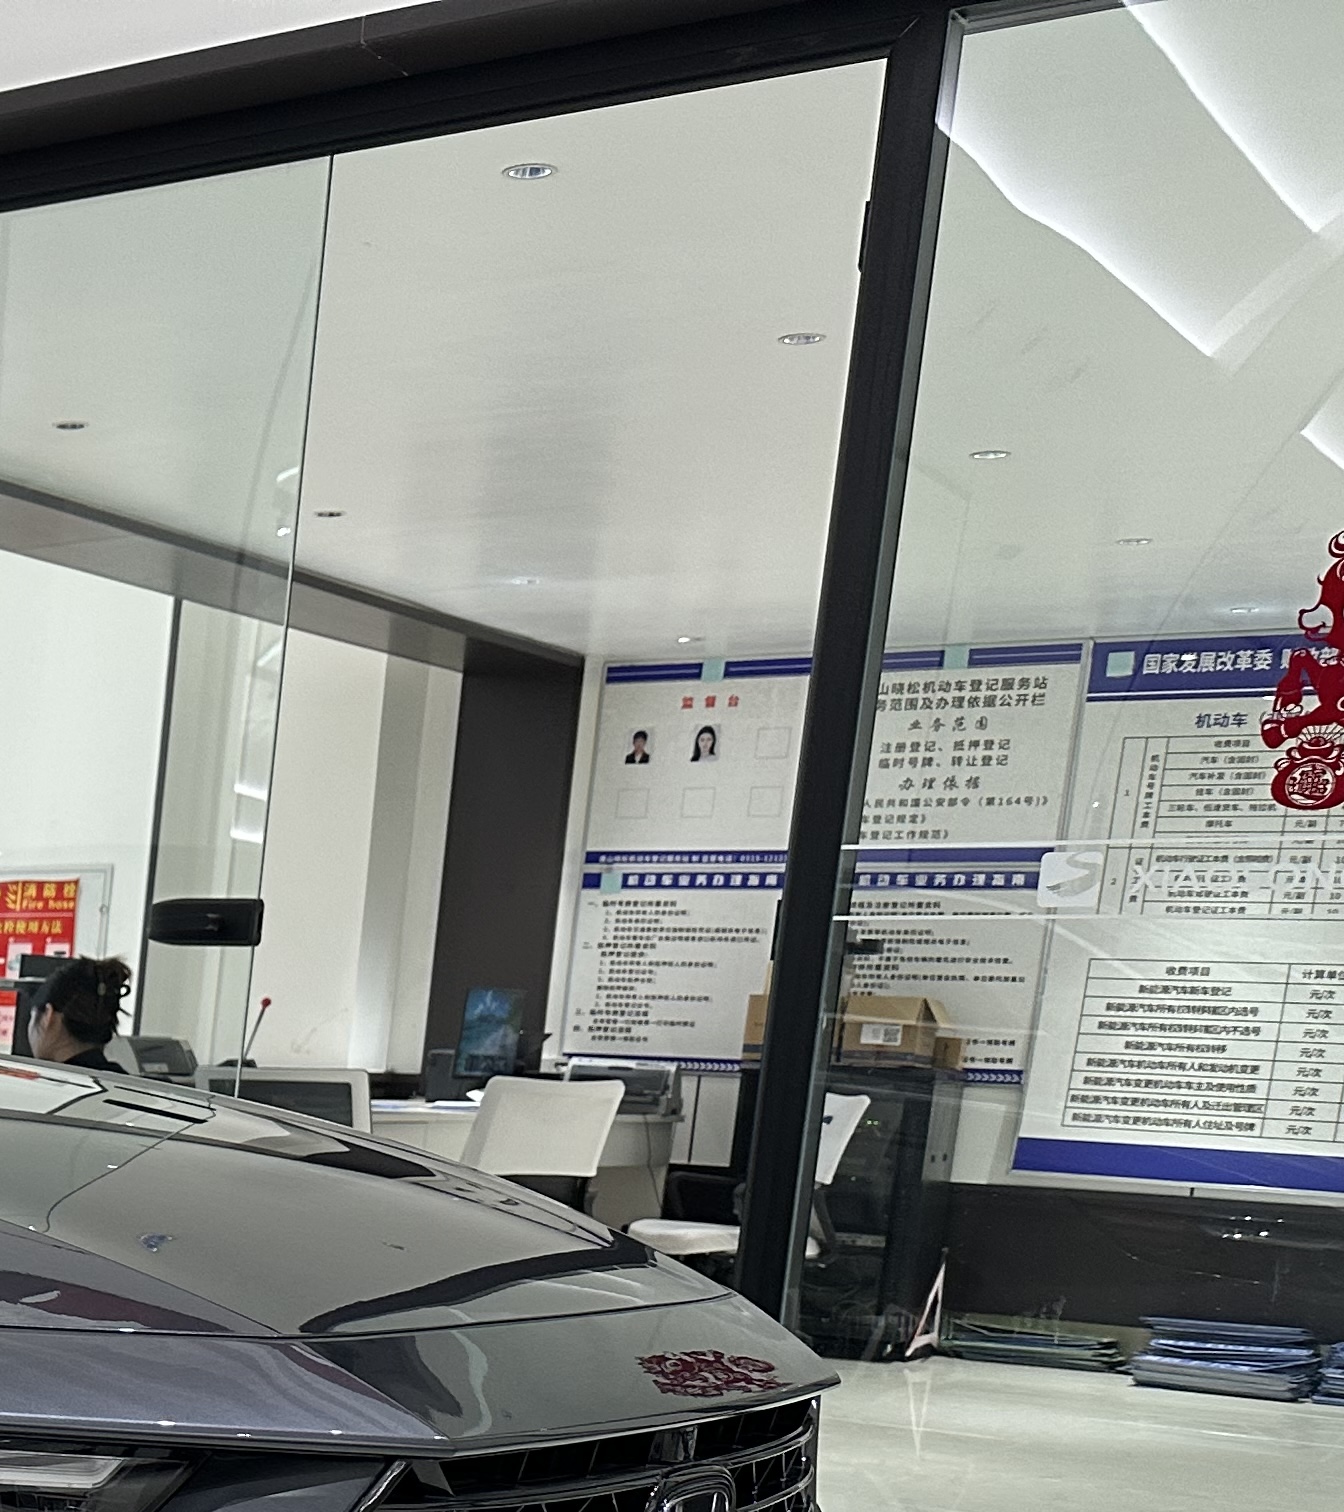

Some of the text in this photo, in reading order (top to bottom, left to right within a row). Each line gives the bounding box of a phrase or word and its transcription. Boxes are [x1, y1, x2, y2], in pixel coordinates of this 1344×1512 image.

[1142, 647, 1273, 676] 国家发展改革委
[908, 716, 989, 732] 业务范围
[899, 776, 982, 791] 办理依据
